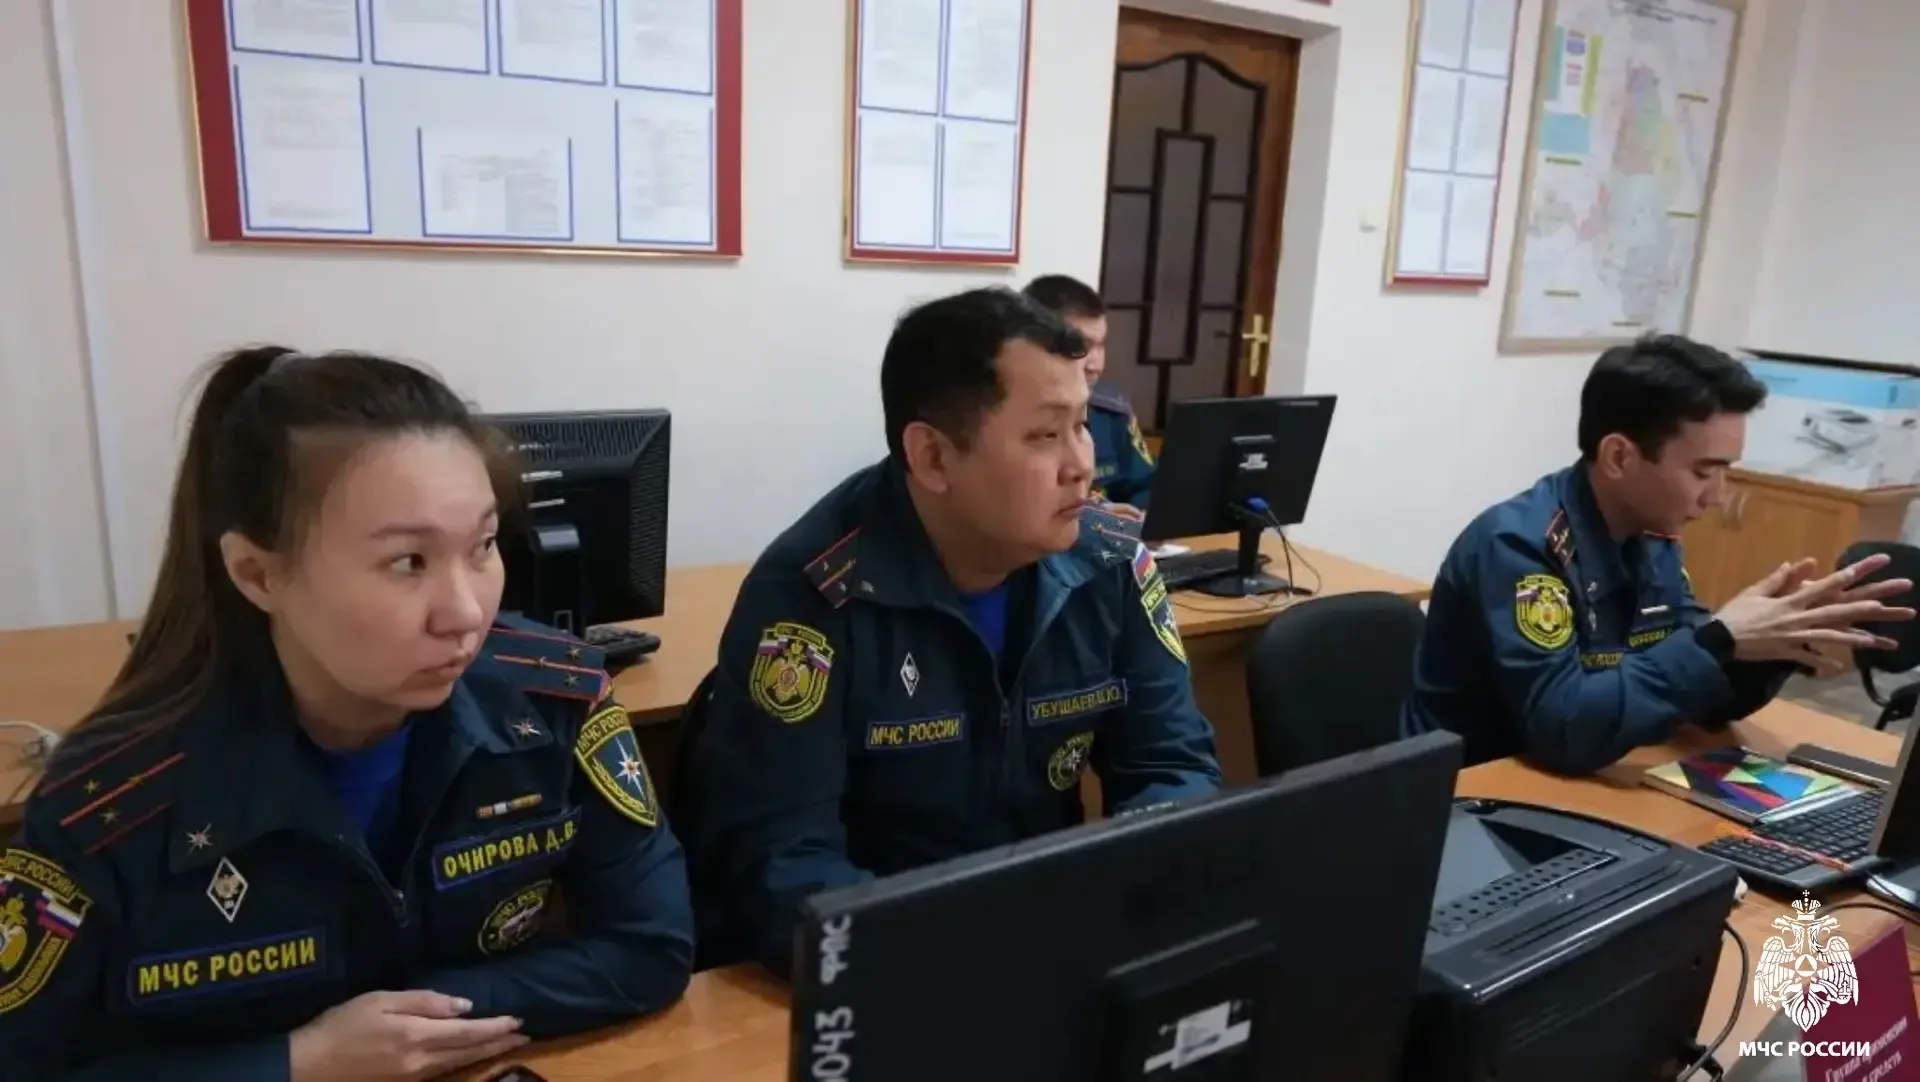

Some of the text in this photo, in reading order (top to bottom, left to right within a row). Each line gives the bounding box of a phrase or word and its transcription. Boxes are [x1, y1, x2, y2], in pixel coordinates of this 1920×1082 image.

[870, 717, 960, 745] МЧС РОССИИ
[443, 832, 538, 878] ОЧИРОВА
[139, 937, 316, 995] МЧС РОССИИ
[811, 1007, 856, 1082] 043
